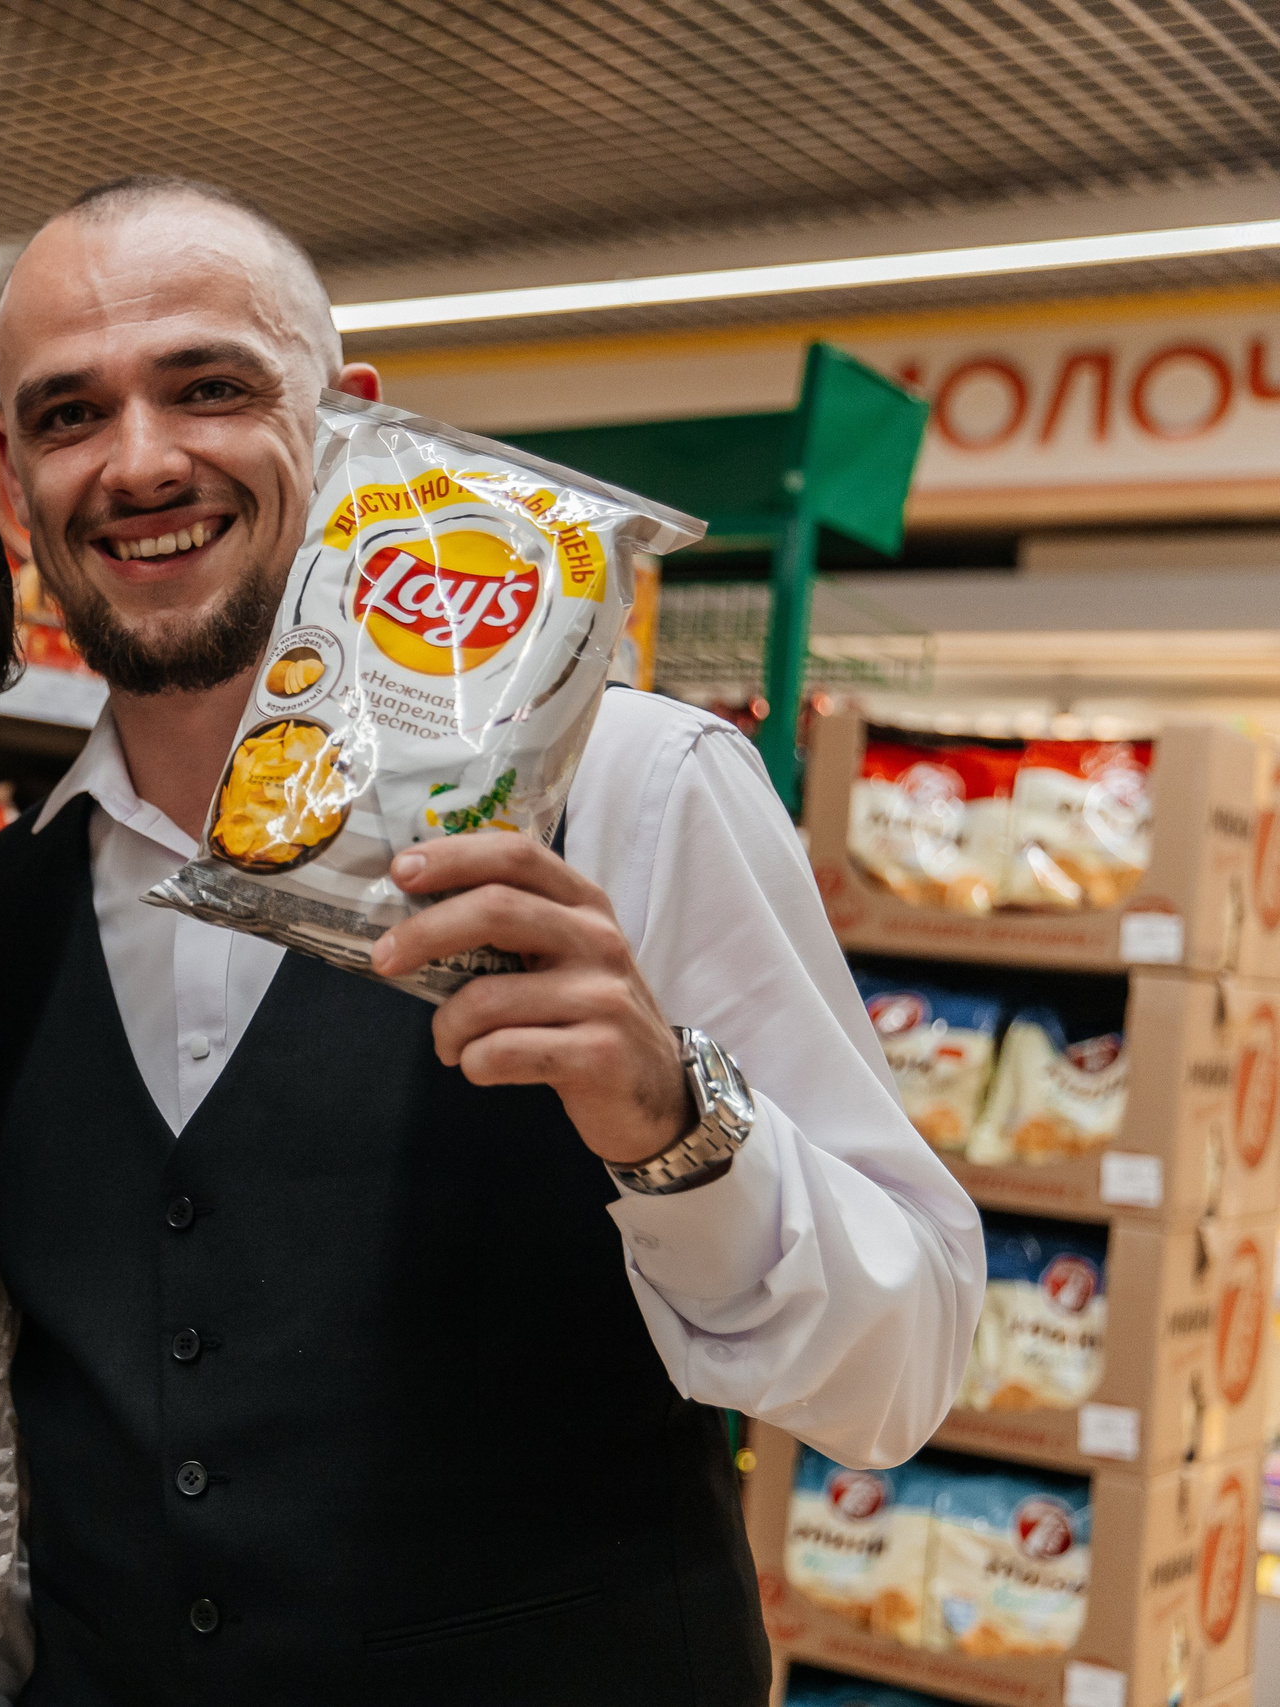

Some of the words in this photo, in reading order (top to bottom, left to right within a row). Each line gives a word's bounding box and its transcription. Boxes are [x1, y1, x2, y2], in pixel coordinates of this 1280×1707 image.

[333, 475, 450, 537] ДОСТУПНО
[360, 550, 532, 648] Lay's
[360, 670, 456, 711] «Нежная
